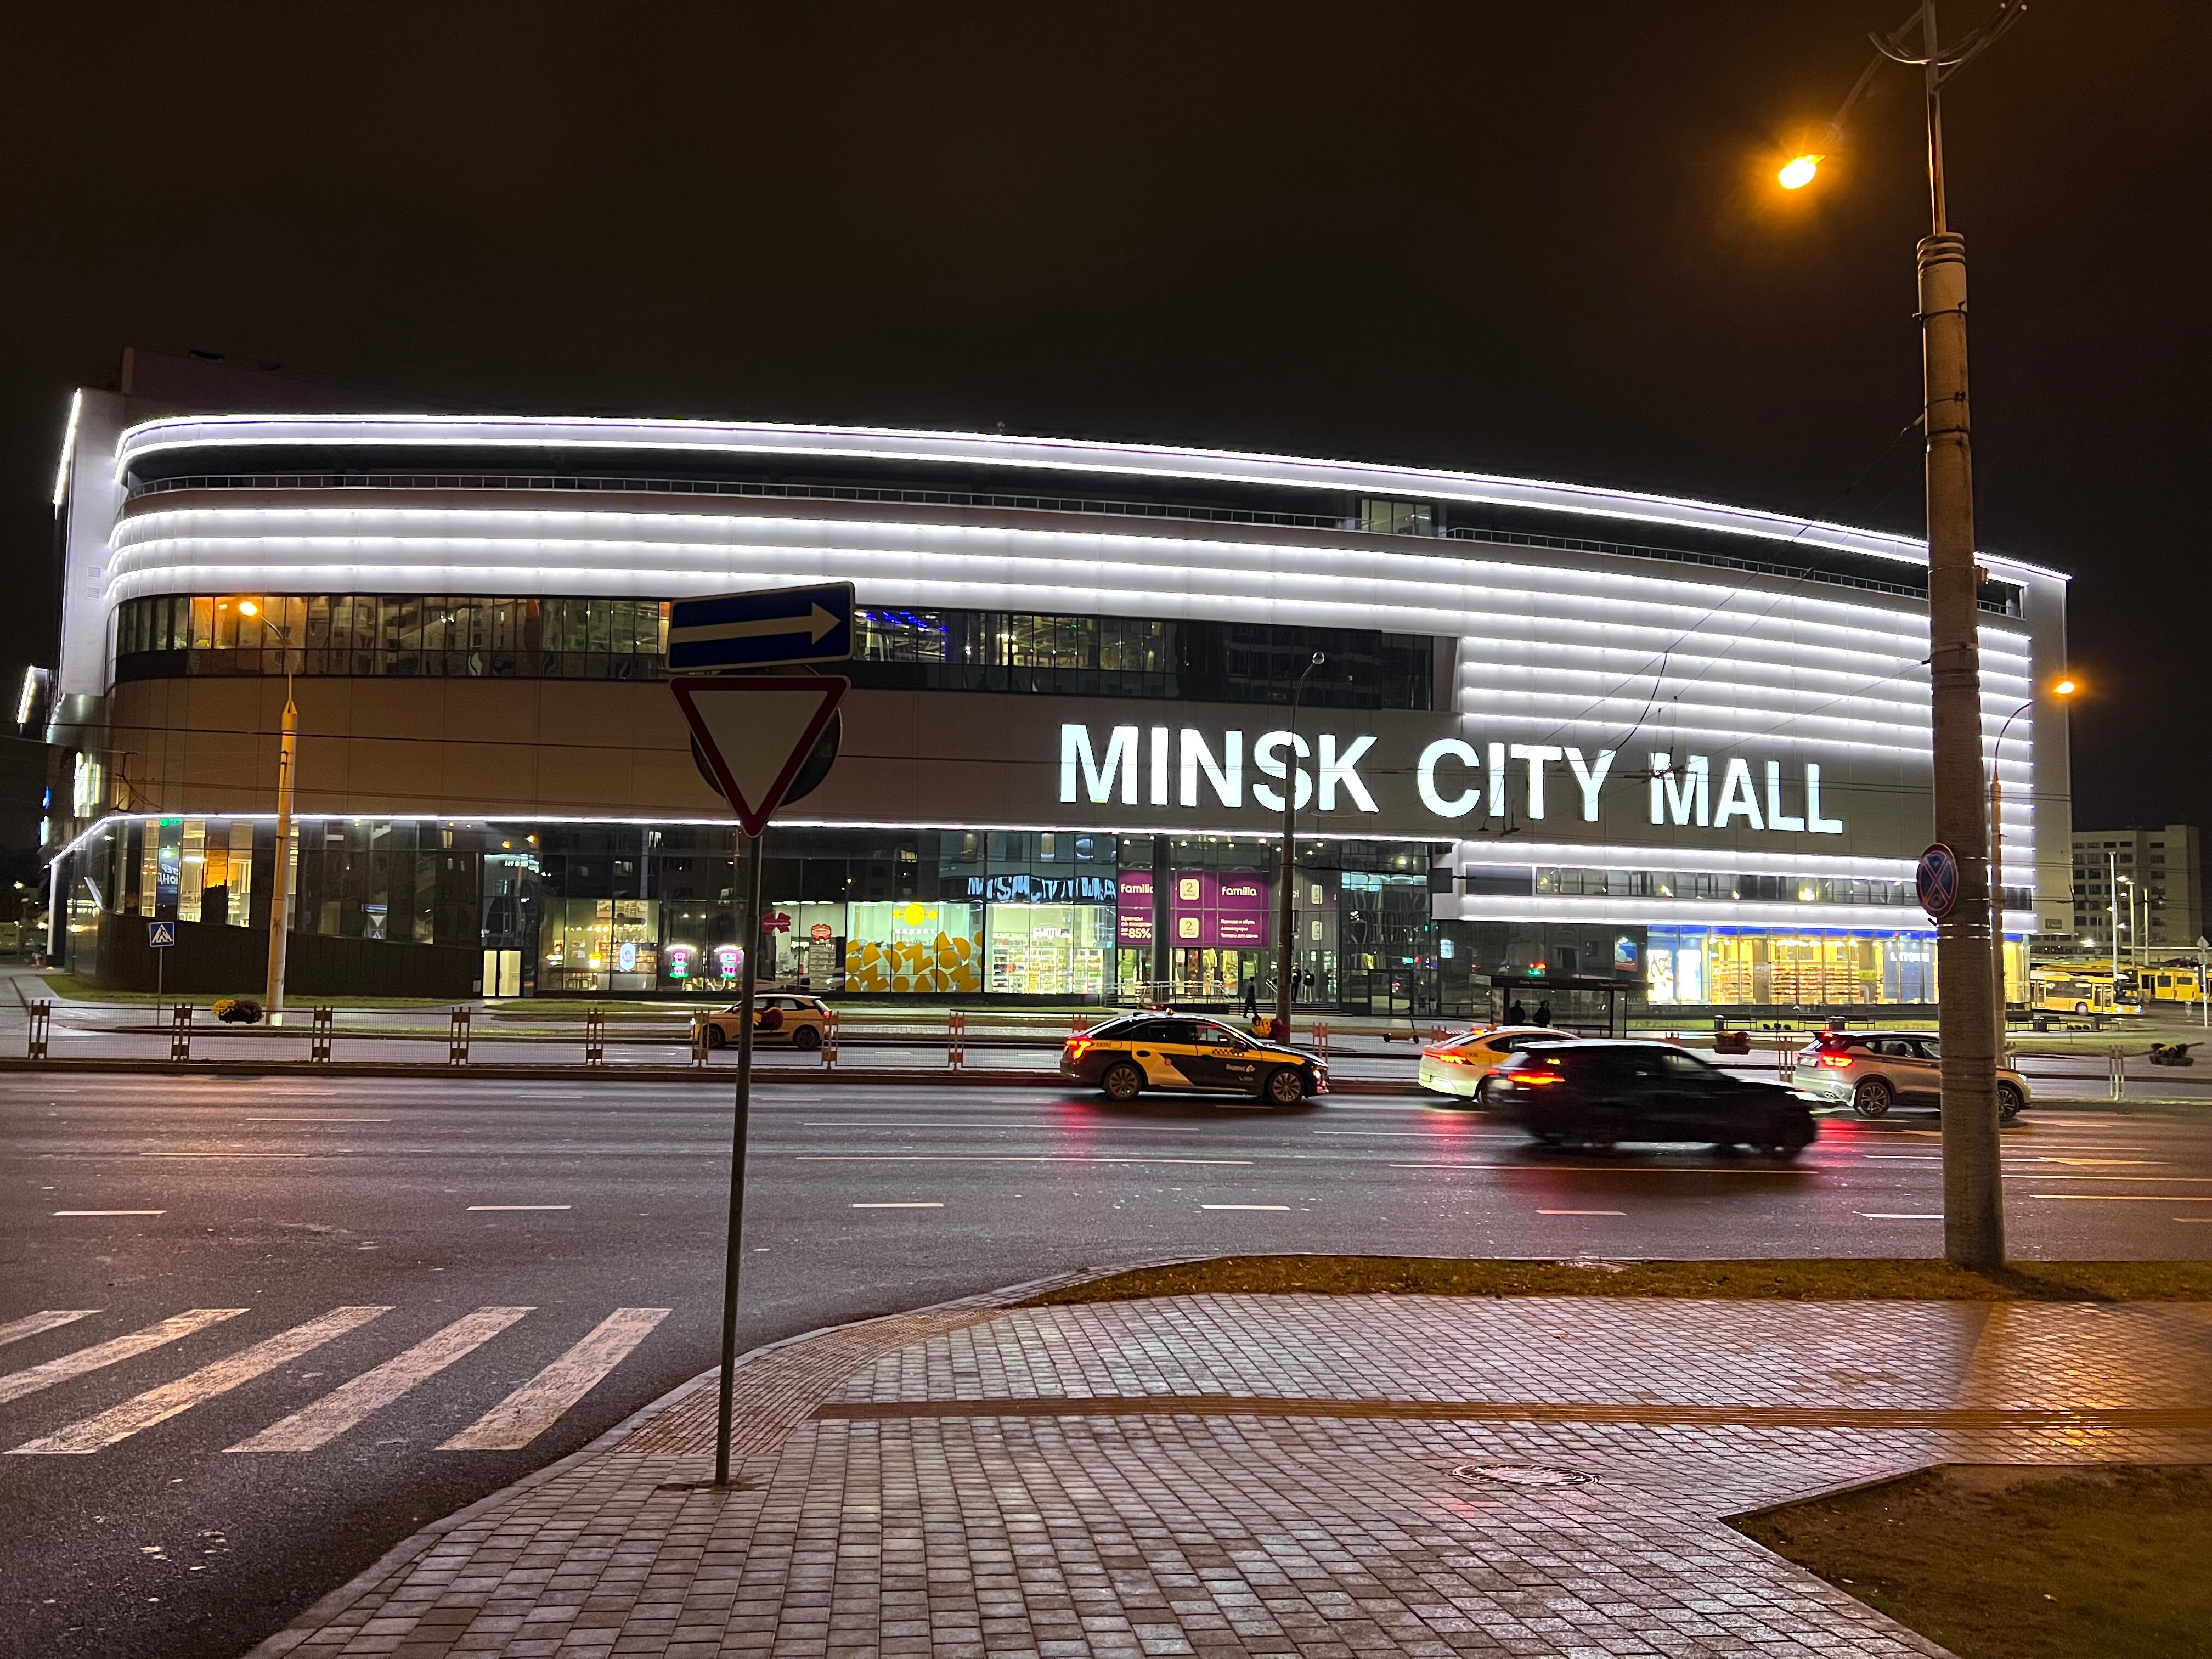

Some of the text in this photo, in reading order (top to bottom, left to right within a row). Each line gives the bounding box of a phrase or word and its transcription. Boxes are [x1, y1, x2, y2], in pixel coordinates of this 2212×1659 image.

[1060, 724, 1843, 834] MINSK CITY MALL
[1186, 883, 1193, 892] 2
[1221, 886, 1257, 896] familia
[1186, 921, 1192, 930] 2
[1128, 928, 1152, 939] 85%
